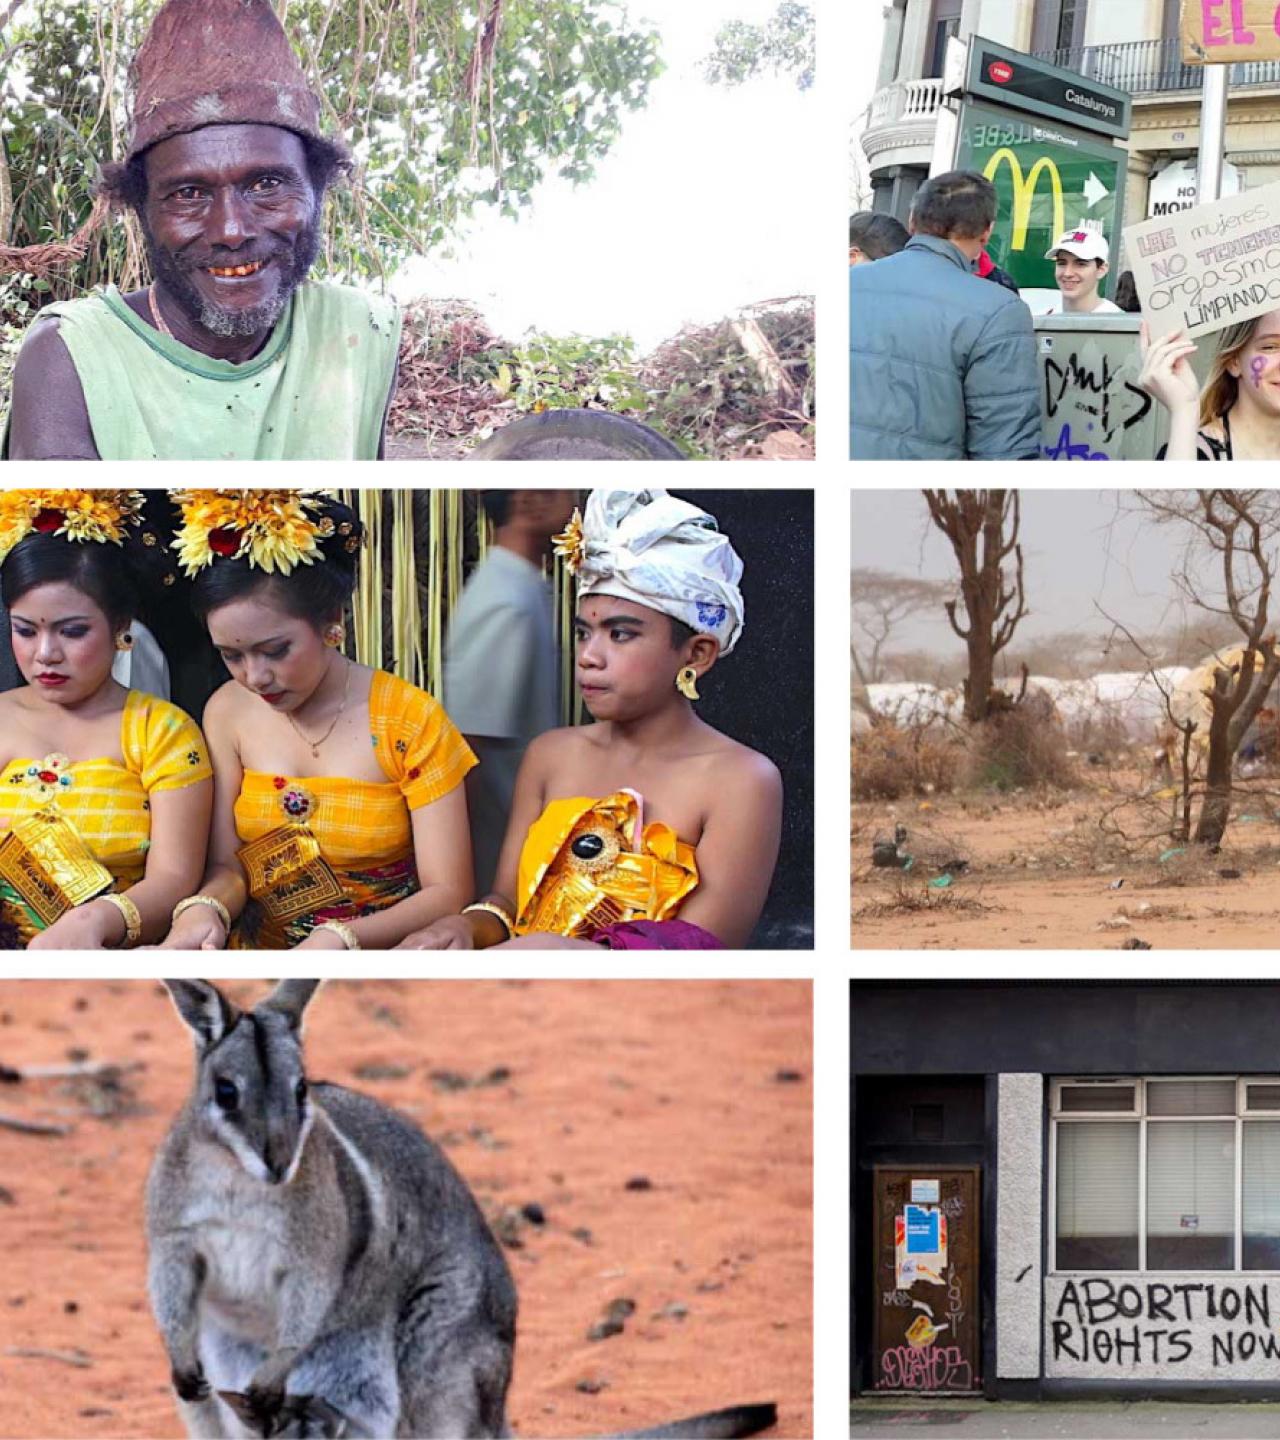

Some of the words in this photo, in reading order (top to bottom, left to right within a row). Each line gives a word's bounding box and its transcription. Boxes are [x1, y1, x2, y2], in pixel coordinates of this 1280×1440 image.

[1203, 0, 1255, 46] EL
[1065, 88, 1116, 118] Catalunya
[1137, 227, 1177, 257] LAS
[1191, 204, 1270, 240] mujeres
[1151, 253, 1188, 282] NO
[1057, 1278, 1270, 1328] ABORTION
[1052, 1320, 1194, 1365] RIGHTS
